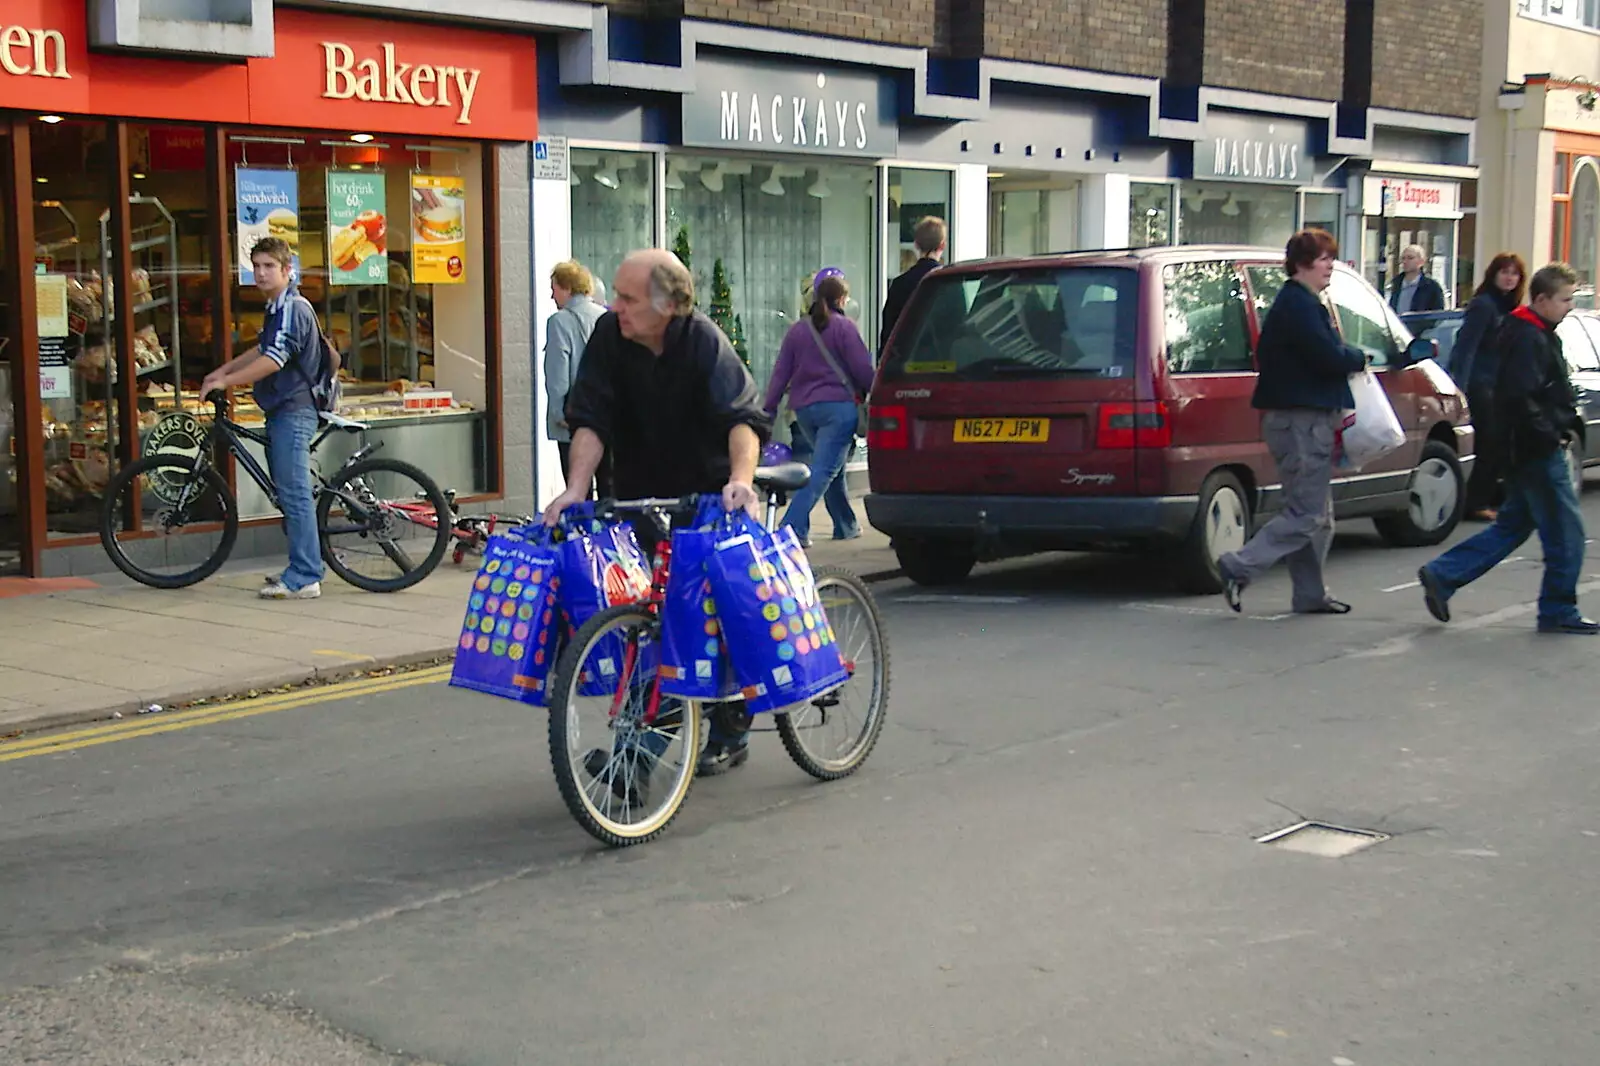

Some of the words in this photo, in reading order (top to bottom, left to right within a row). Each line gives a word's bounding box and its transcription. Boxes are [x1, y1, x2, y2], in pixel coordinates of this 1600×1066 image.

[0, 25, 72, 79] en
[320, 41, 481, 125] Bakery
[720, 90, 867, 150] MACKAYS
[1213, 137, 1298, 180] MACKAYS
[333, 182, 347, 195] hot
[348, 182, 374, 196] drink
[346, 194, 364, 209] 60p
[1404, 181, 1440, 208] Express
[145, 416, 181, 457] BAKERS
[184, 419, 207, 447] OVE
[962, 420, 1004, 438] N627
[1008, 420, 1041, 437] JPW
